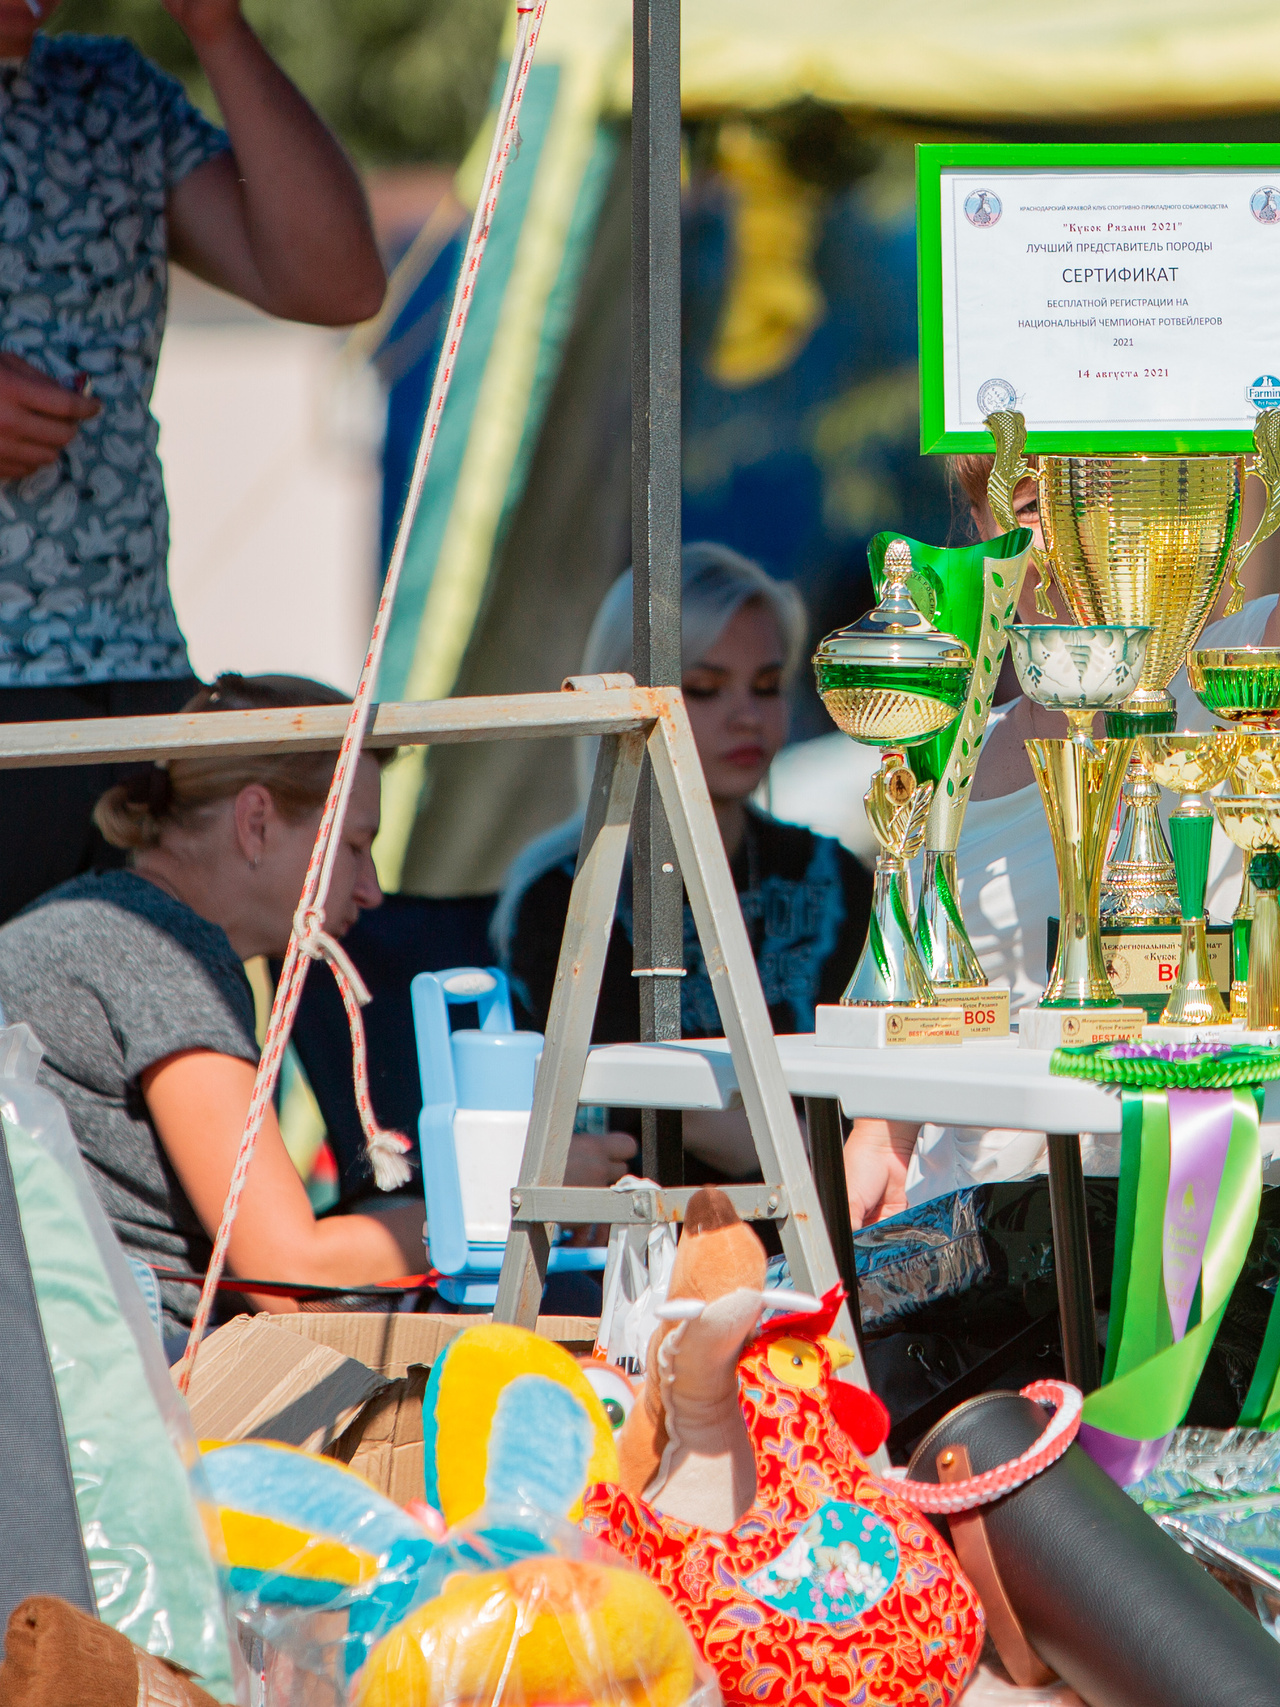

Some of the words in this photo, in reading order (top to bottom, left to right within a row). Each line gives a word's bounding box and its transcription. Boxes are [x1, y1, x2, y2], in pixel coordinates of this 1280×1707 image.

[1020, 204, 1066, 212] КРАСНОДАРСКИЙ
[1026, 242, 1073, 253] ЛУЧШИЙ
[1076, 242, 1163, 254] ПРЕДСТАВИТЕЛЬ
[1166, 241, 1213, 253] ПОРОДЫ
[1062, 267, 1179, 283] СЕРТИФИКАТ
[1047, 297, 1107, 308] БЕСПЛАТНОЙ
[1110, 298, 1174, 308] РЕГИСТРАЦИИ
[1176, 298, 1189, 307] НА
[1018, 317, 1097, 329] НАЦИОНАЛЬНЫЙ
[1099, 318, 1156, 327] ЧЕМПИОНАТ
[1158, 316, 1223, 326] РОТВЕЙЛЕРОВ
[1113, 338, 1134, 347] 2021
[1078, 369, 1090, 378] 14
[1095, 370, 1139, 380] августа
[1144, 368, 1169, 378] 2021
[964, 1010, 996, 1025] BOS
[1091, 1034, 1115, 1043] BEST
